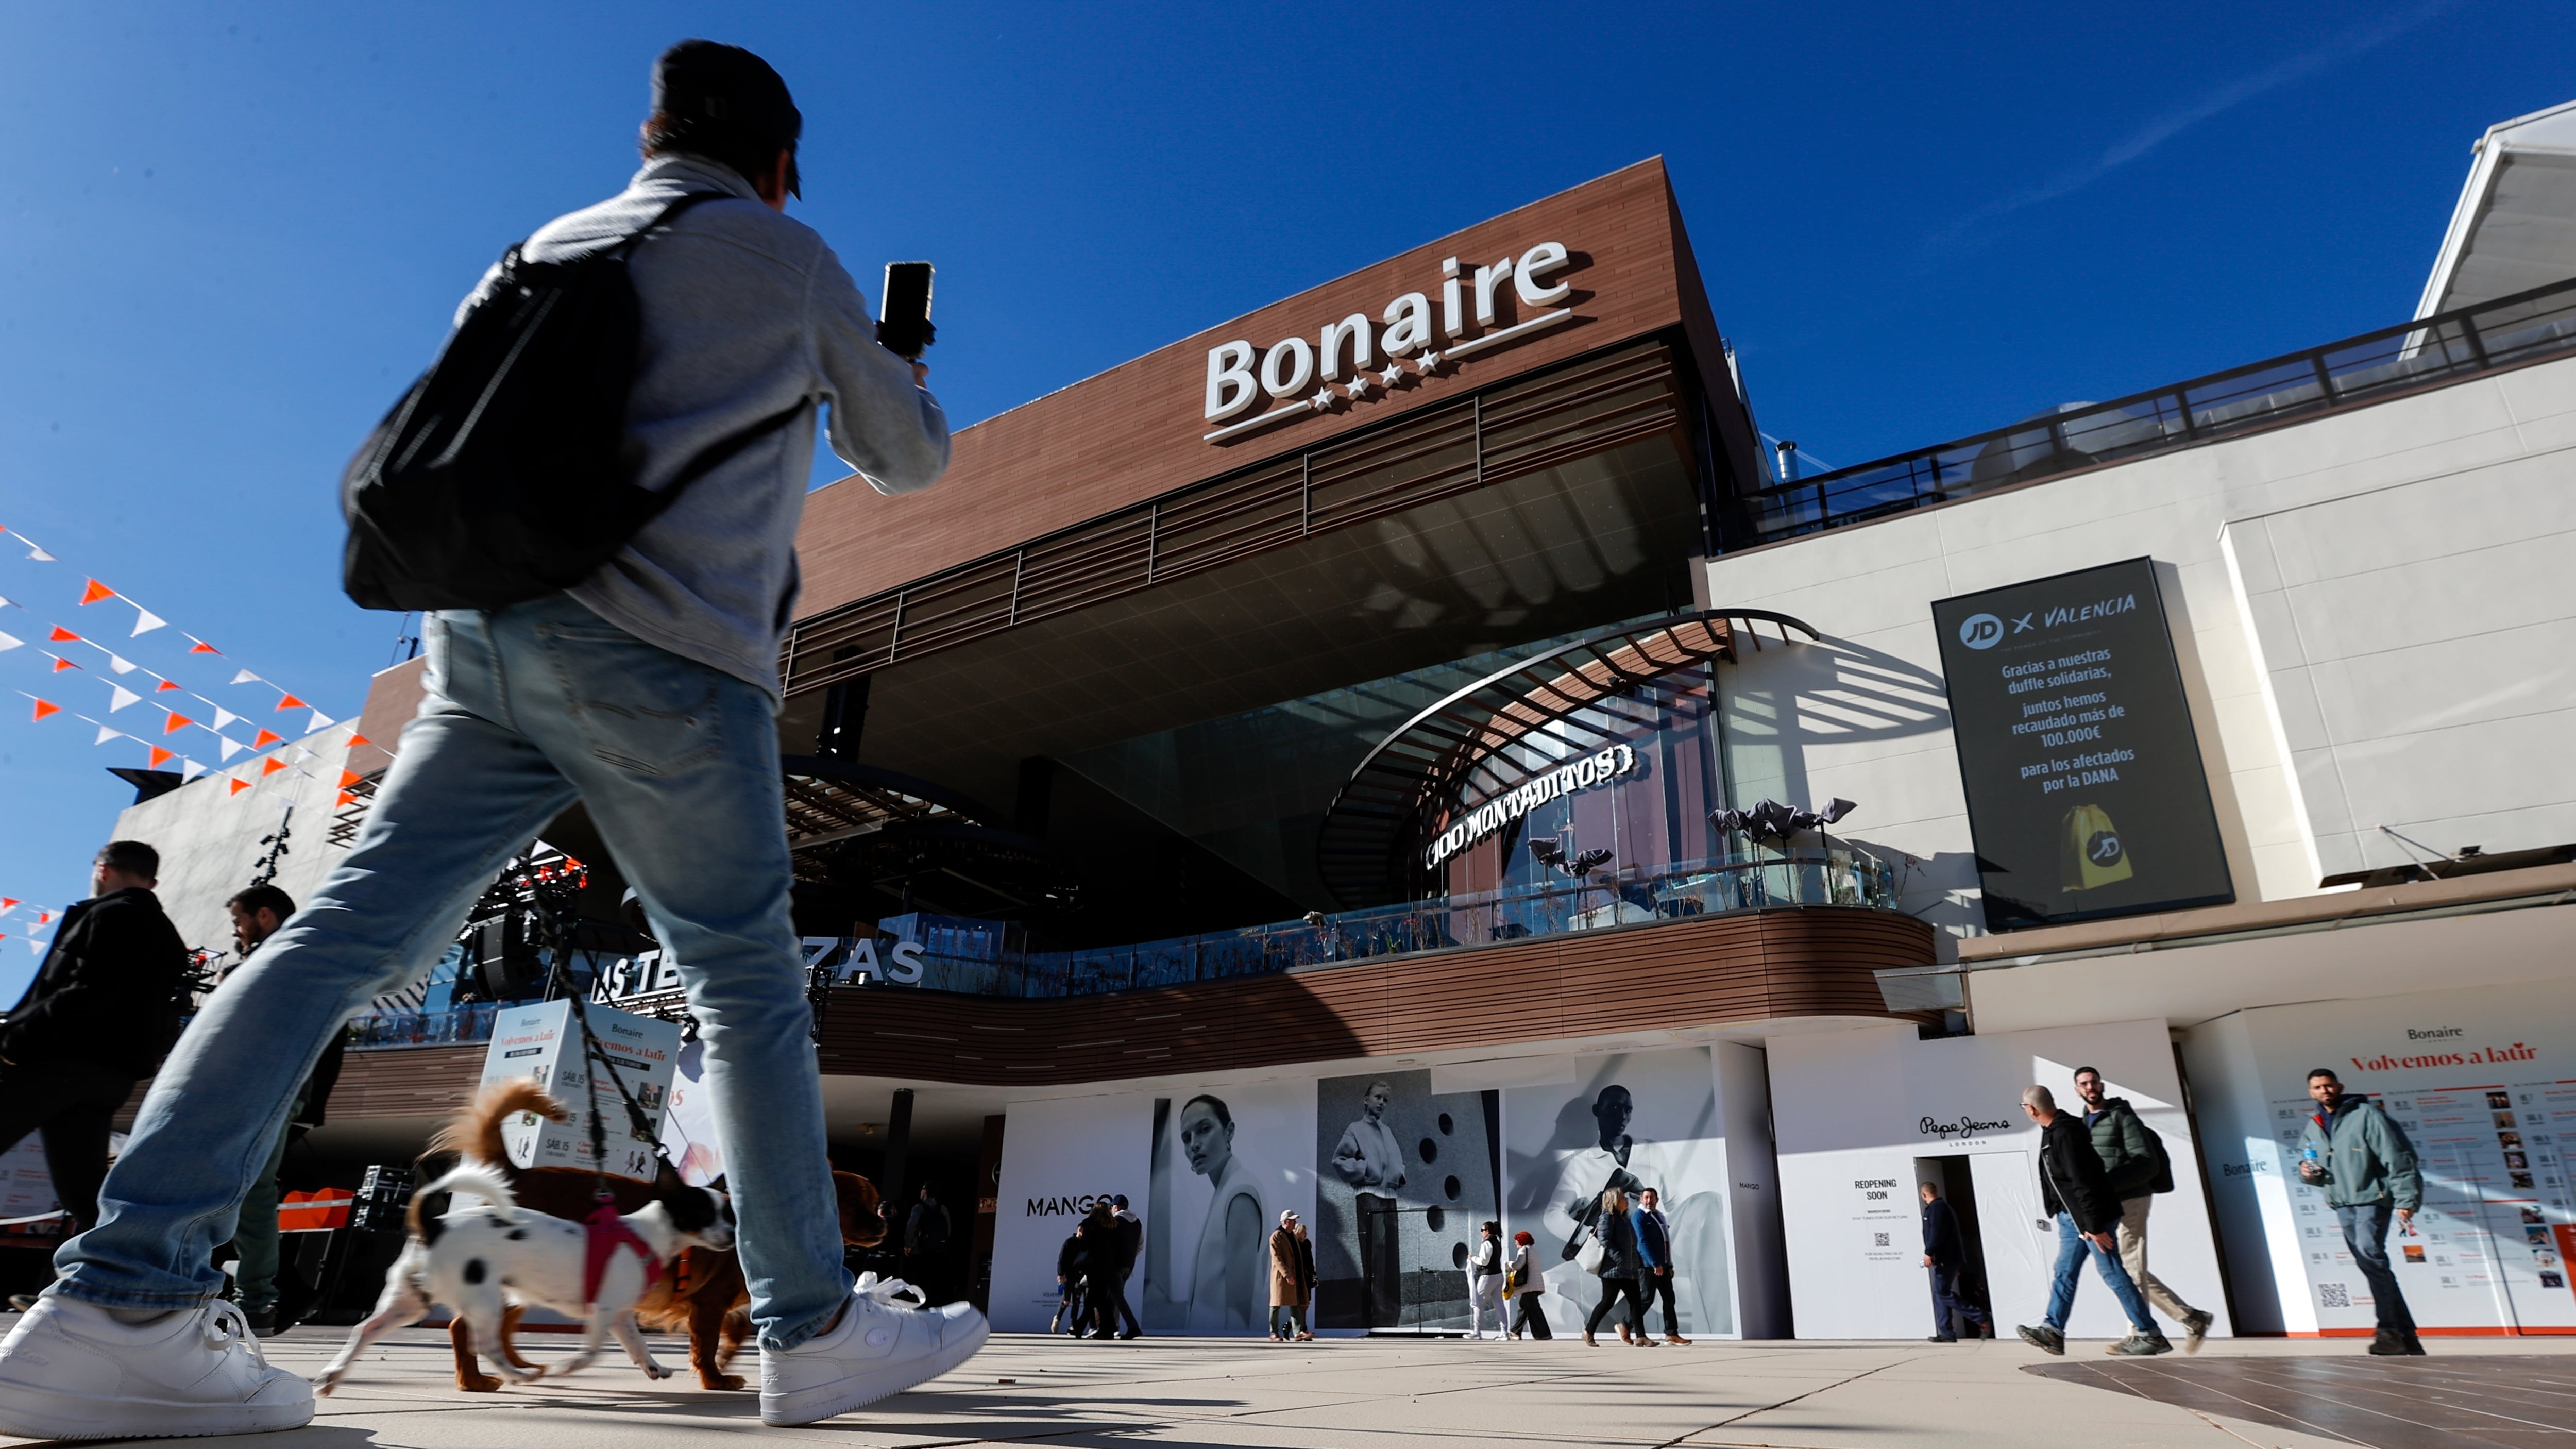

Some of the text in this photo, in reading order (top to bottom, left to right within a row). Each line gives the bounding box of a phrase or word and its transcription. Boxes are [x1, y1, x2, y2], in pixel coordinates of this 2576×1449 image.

[1205, 241, 1571, 424] Bonaire
[2044, 594, 2136, 628] VALENCIA
[2002, 649, 2111, 679] Gracias a nuestras
[2008, 667, 2112, 694] duffle solidarias,
[2022, 692, 2107, 718] juntos hemos
[2012, 705, 2125, 735] recaudado más de
[2041, 726, 2102, 748] 100.000€
[2020, 749, 2135, 780] para los afectados
[2043, 768, 2120, 794] por la DANA
[1433, 746, 1616, 864] 100 MONTADITOS
[612, 1023, 643, 1038] Bonaire
[2407, 1026, 2463, 1040] Bonaire
[645, 1047, 667, 1061] latir
[2351, 1042, 2537, 1071] Volvemos a latir
[1920, 1116, 2011, 1139] Pepe Jeans
[2223, 1159, 2267, 1176] Bonaire
[1855, 1179, 1897, 1189] REOPENING
[1867, 1191, 1888, 1200] SOON
